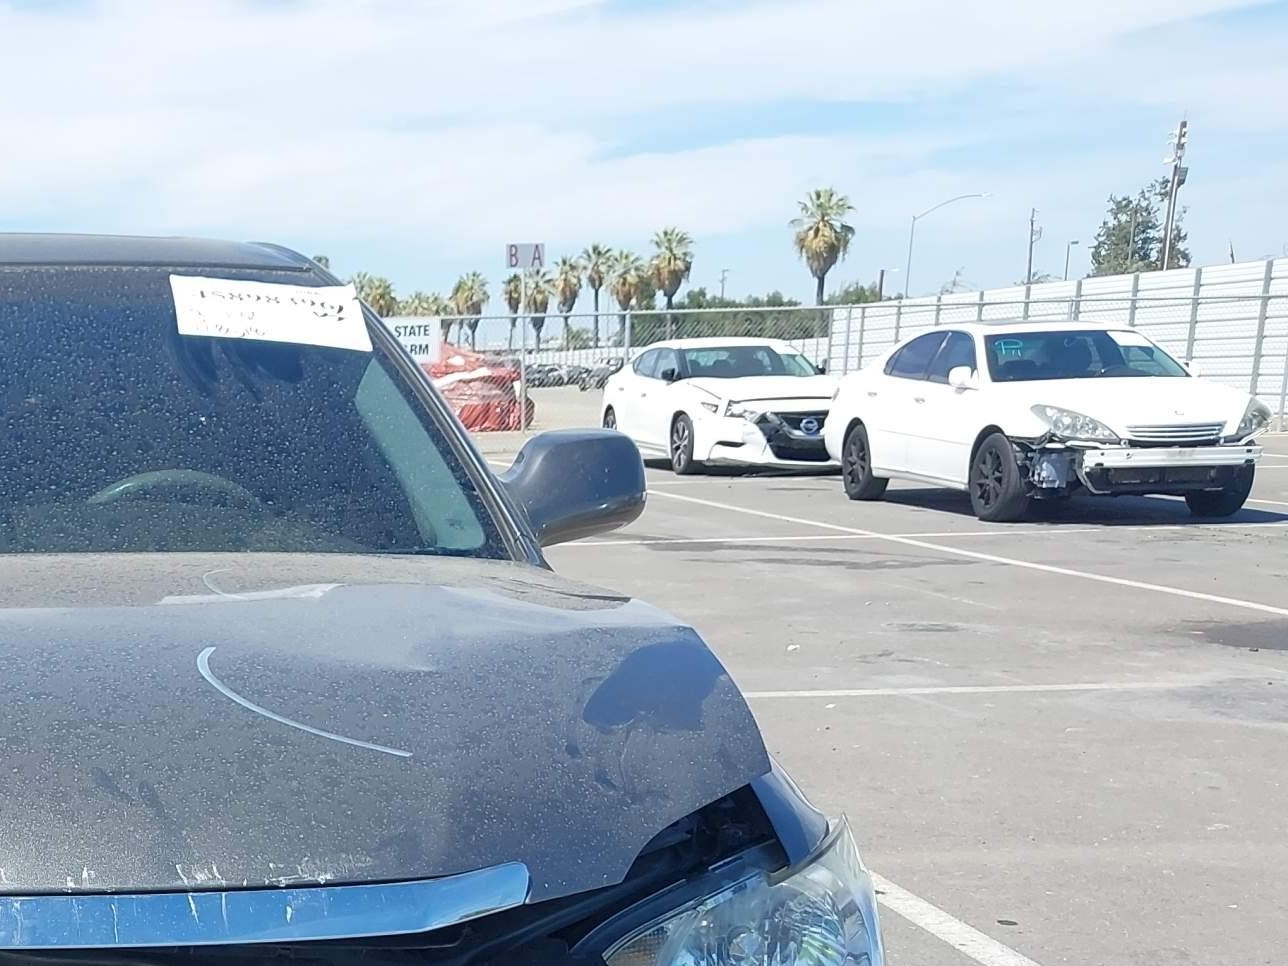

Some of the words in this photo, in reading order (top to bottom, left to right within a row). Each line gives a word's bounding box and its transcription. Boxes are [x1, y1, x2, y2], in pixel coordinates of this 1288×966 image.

[509, 244, 519, 267] B
[531, 244, 543, 267] A
[394, 325, 430, 337] STATE
